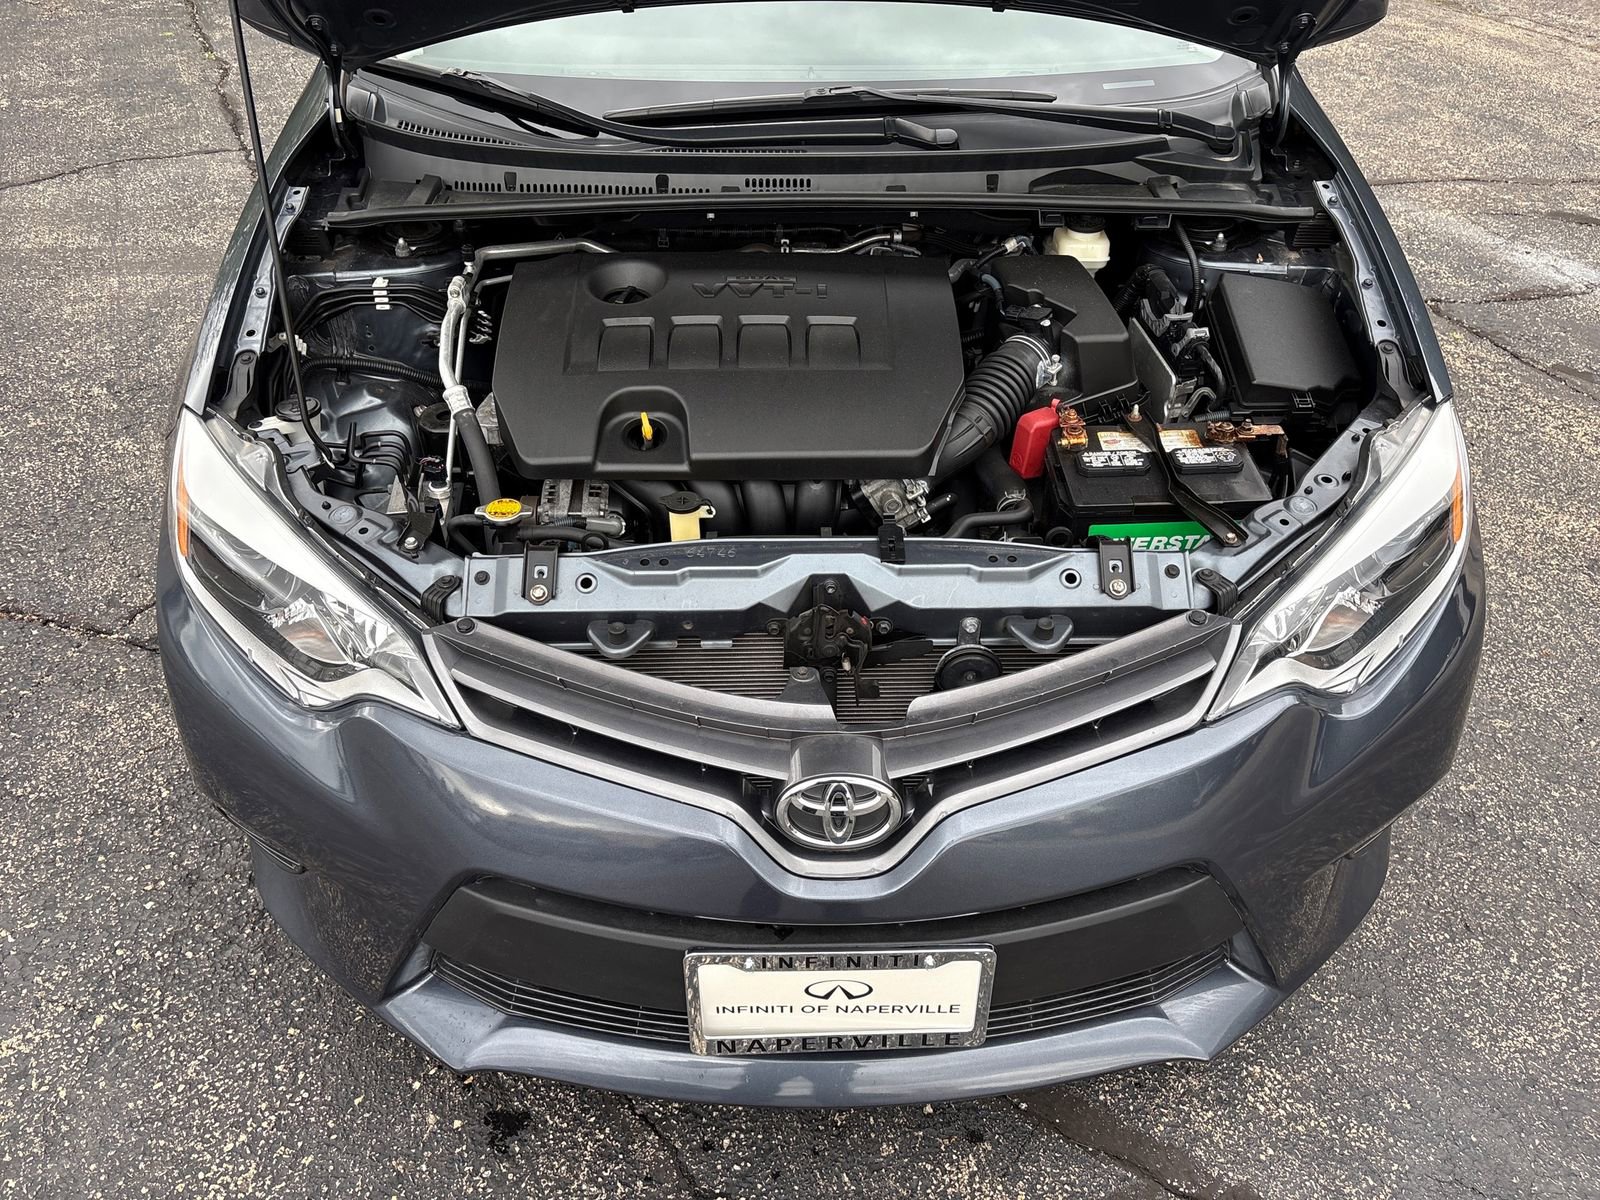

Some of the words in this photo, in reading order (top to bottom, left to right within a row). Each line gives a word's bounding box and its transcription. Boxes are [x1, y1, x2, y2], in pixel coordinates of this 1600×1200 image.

[1112, 534, 1212, 553] ERSTA
[761, 954, 919, 969] INFINITI
[716, 1005, 794, 1014] INFINITI
[801, 1005, 825, 1014] OF
[835, 1004, 961, 1014] NAPERVILLE
[716, 1033, 961, 1054] NAPERVILLE
